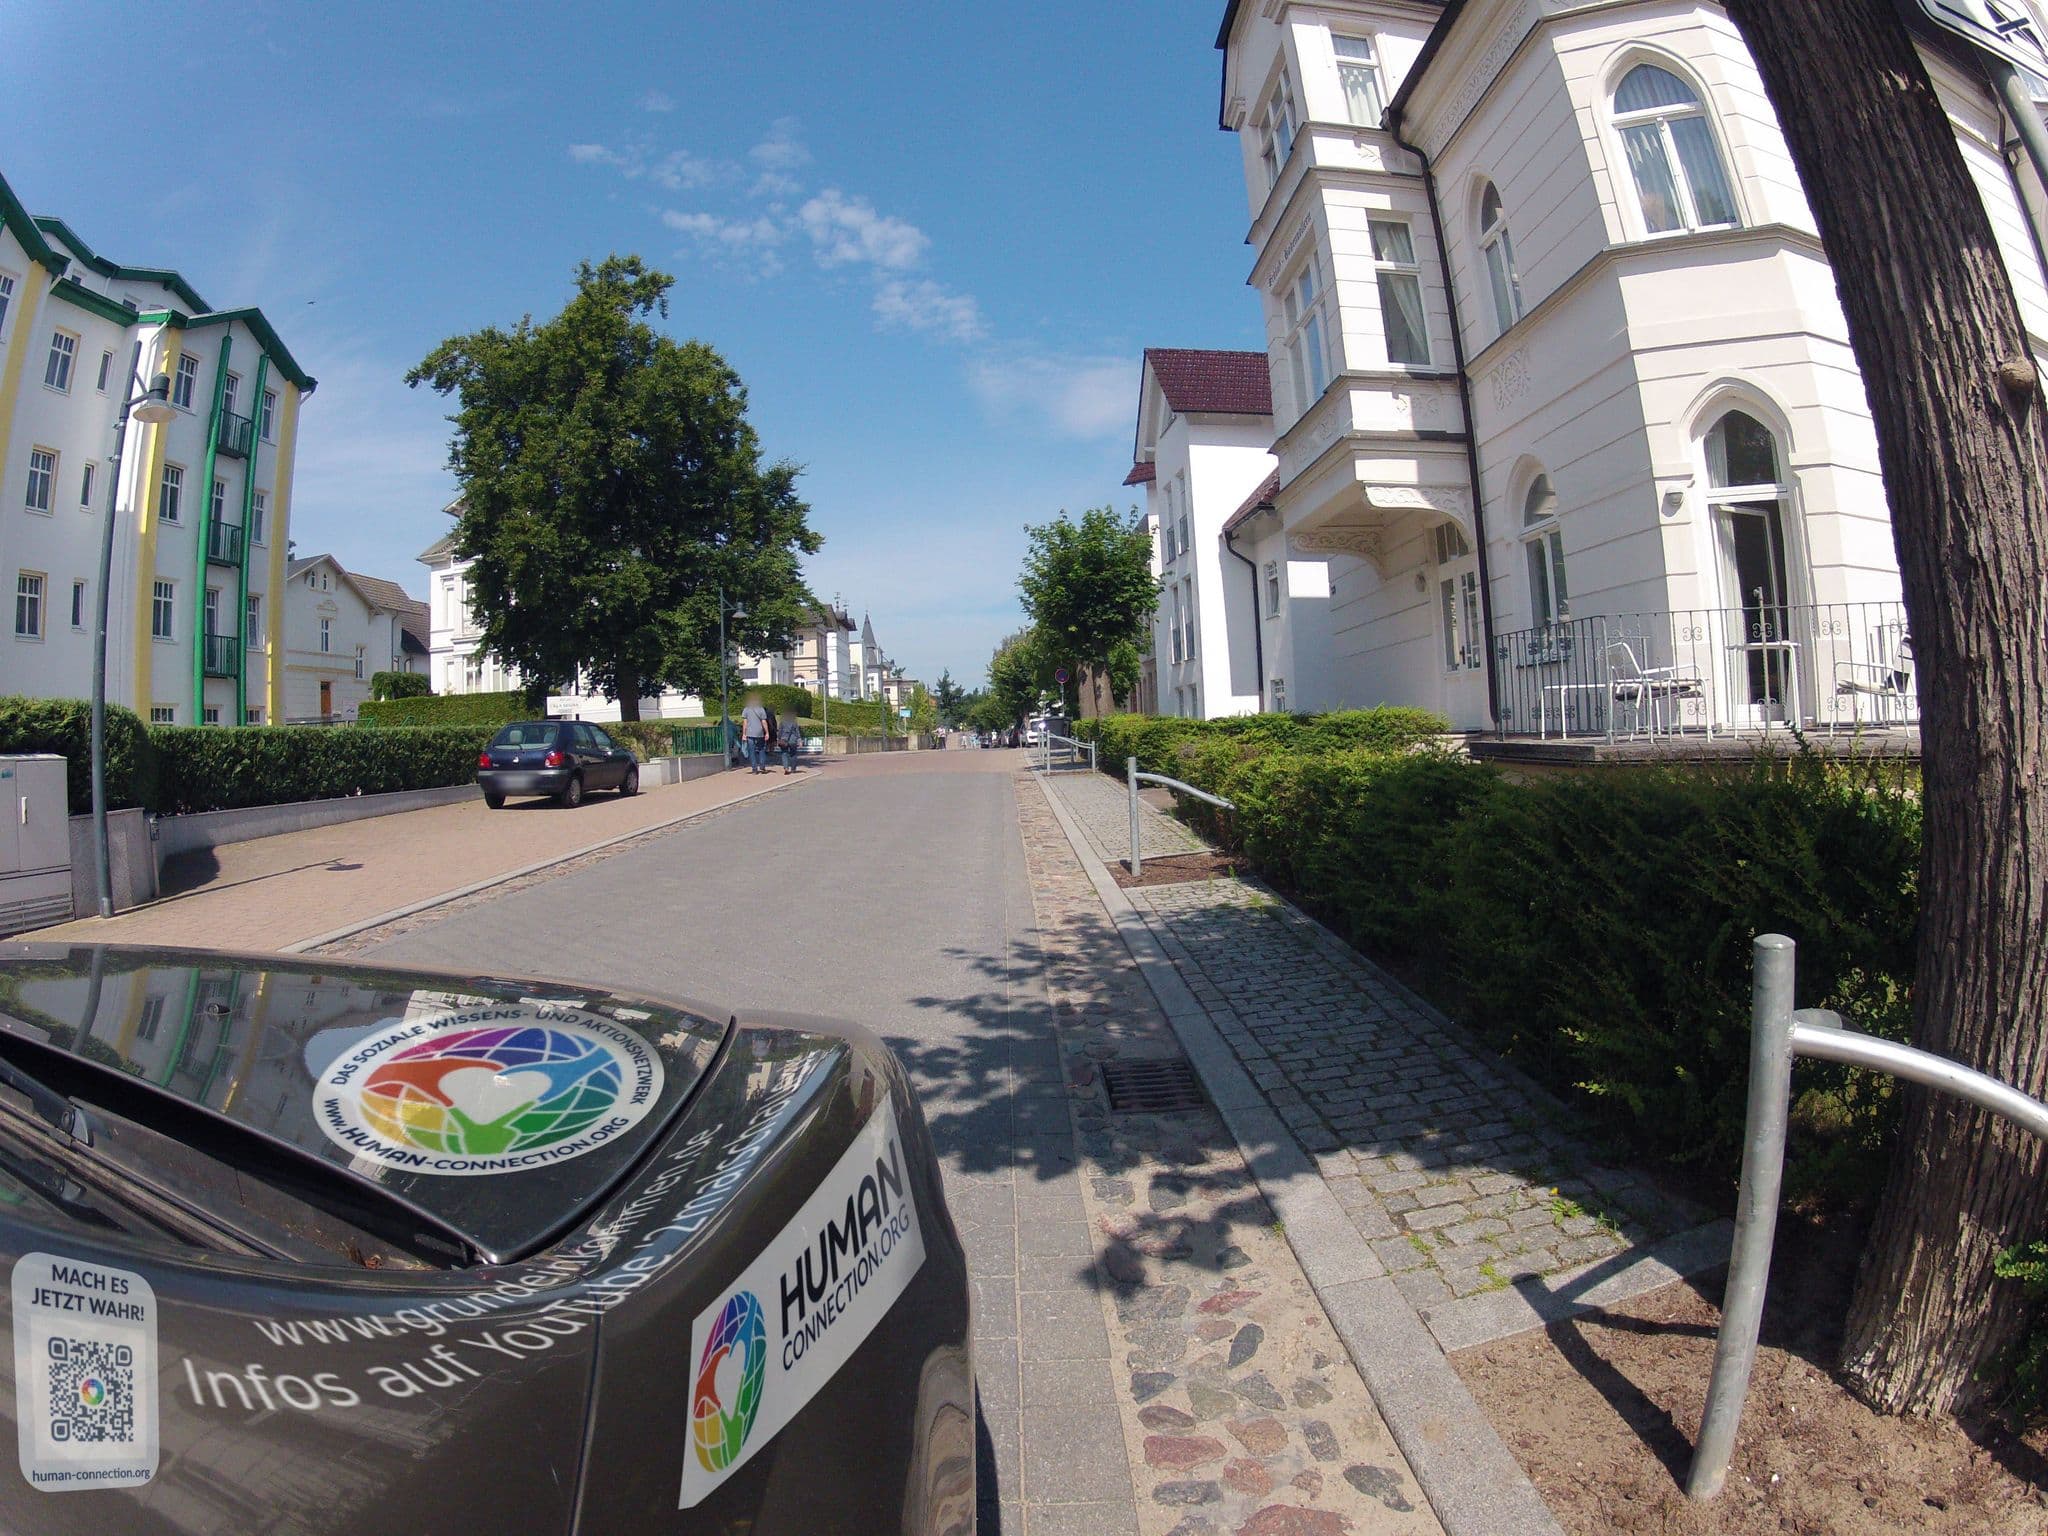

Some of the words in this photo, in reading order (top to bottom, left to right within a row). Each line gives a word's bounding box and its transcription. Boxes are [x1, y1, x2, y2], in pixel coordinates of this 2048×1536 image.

[330, 1064, 359, 1086] DAS
[353, 1025, 425, 1063] SOZIALE
[427, 1009, 529, 1030] WISSENS-
[536, 1012, 580, 1025] UND
[578, 1018, 653, 1105] AKTIONSNETZWERK
[51, 1264, 106, 1291] MACH
[111, 1277, 129, 1295] ES
[779, 1137, 905, 1339] HUMAN
[31, 1287, 85, 1312] JETZT
[89, 1297, 145, 1321] WAHR!
[183, 1357, 361, 1413] Infos
[366, 1344, 480, 1400] auf
[459, 1254, 672, 1361] YouTube
[782, 1204, 911, 1372] CONNECTION.ORG
[32, 1467, 151, 1482] human-connection.org
